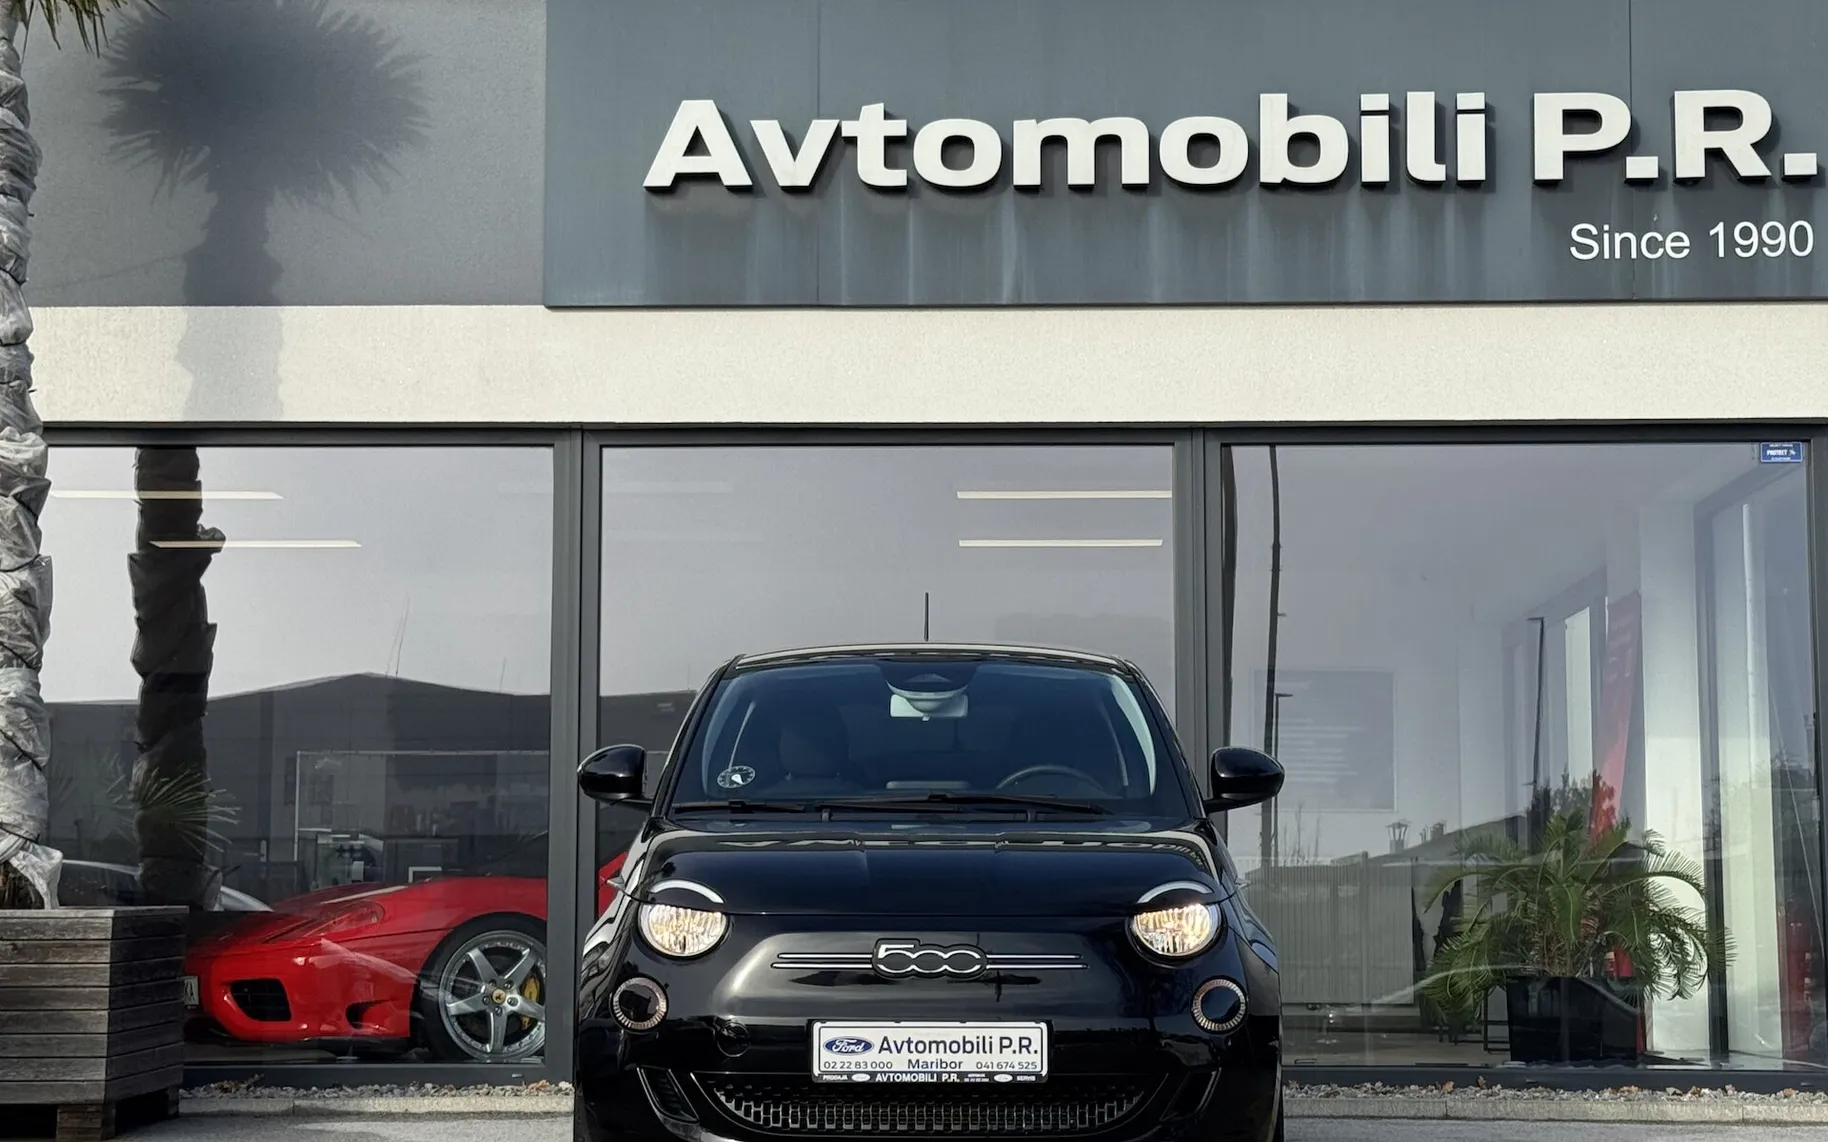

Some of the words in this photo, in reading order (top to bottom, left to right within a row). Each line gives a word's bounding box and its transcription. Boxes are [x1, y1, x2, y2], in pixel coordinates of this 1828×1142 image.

[643, 91, 1486, 190] Avtomobili
[1533, 90, 1818, 184] P.R.
[1570, 218, 1690, 260] Since
[1708, 219, 1815, 258] 1990
[876, 943, 983, 974] 500
[831, 1038, 867, 1053] Ford
[878, 1035, 993, 1055] Avtomobili
[999, 1036, 1039, 1055] P.R.
[823, 1061, 838, 1070] 02
[839, 1061, 853, 1070] 22
[854, 1061, 868, 1070] 83
[870, 1061, 893, 1070] 000
[907, 1058, 963, 1070] Maribor
[976, 1061, 994, 1070] 041
[996, 1061, 1015, 1070] 674
[1017, 1061, 1038, 1070] 525
[875, 1073, 937, 1082] AVTOMOBILI
[941, 1073, 960, 1082] P.R.
